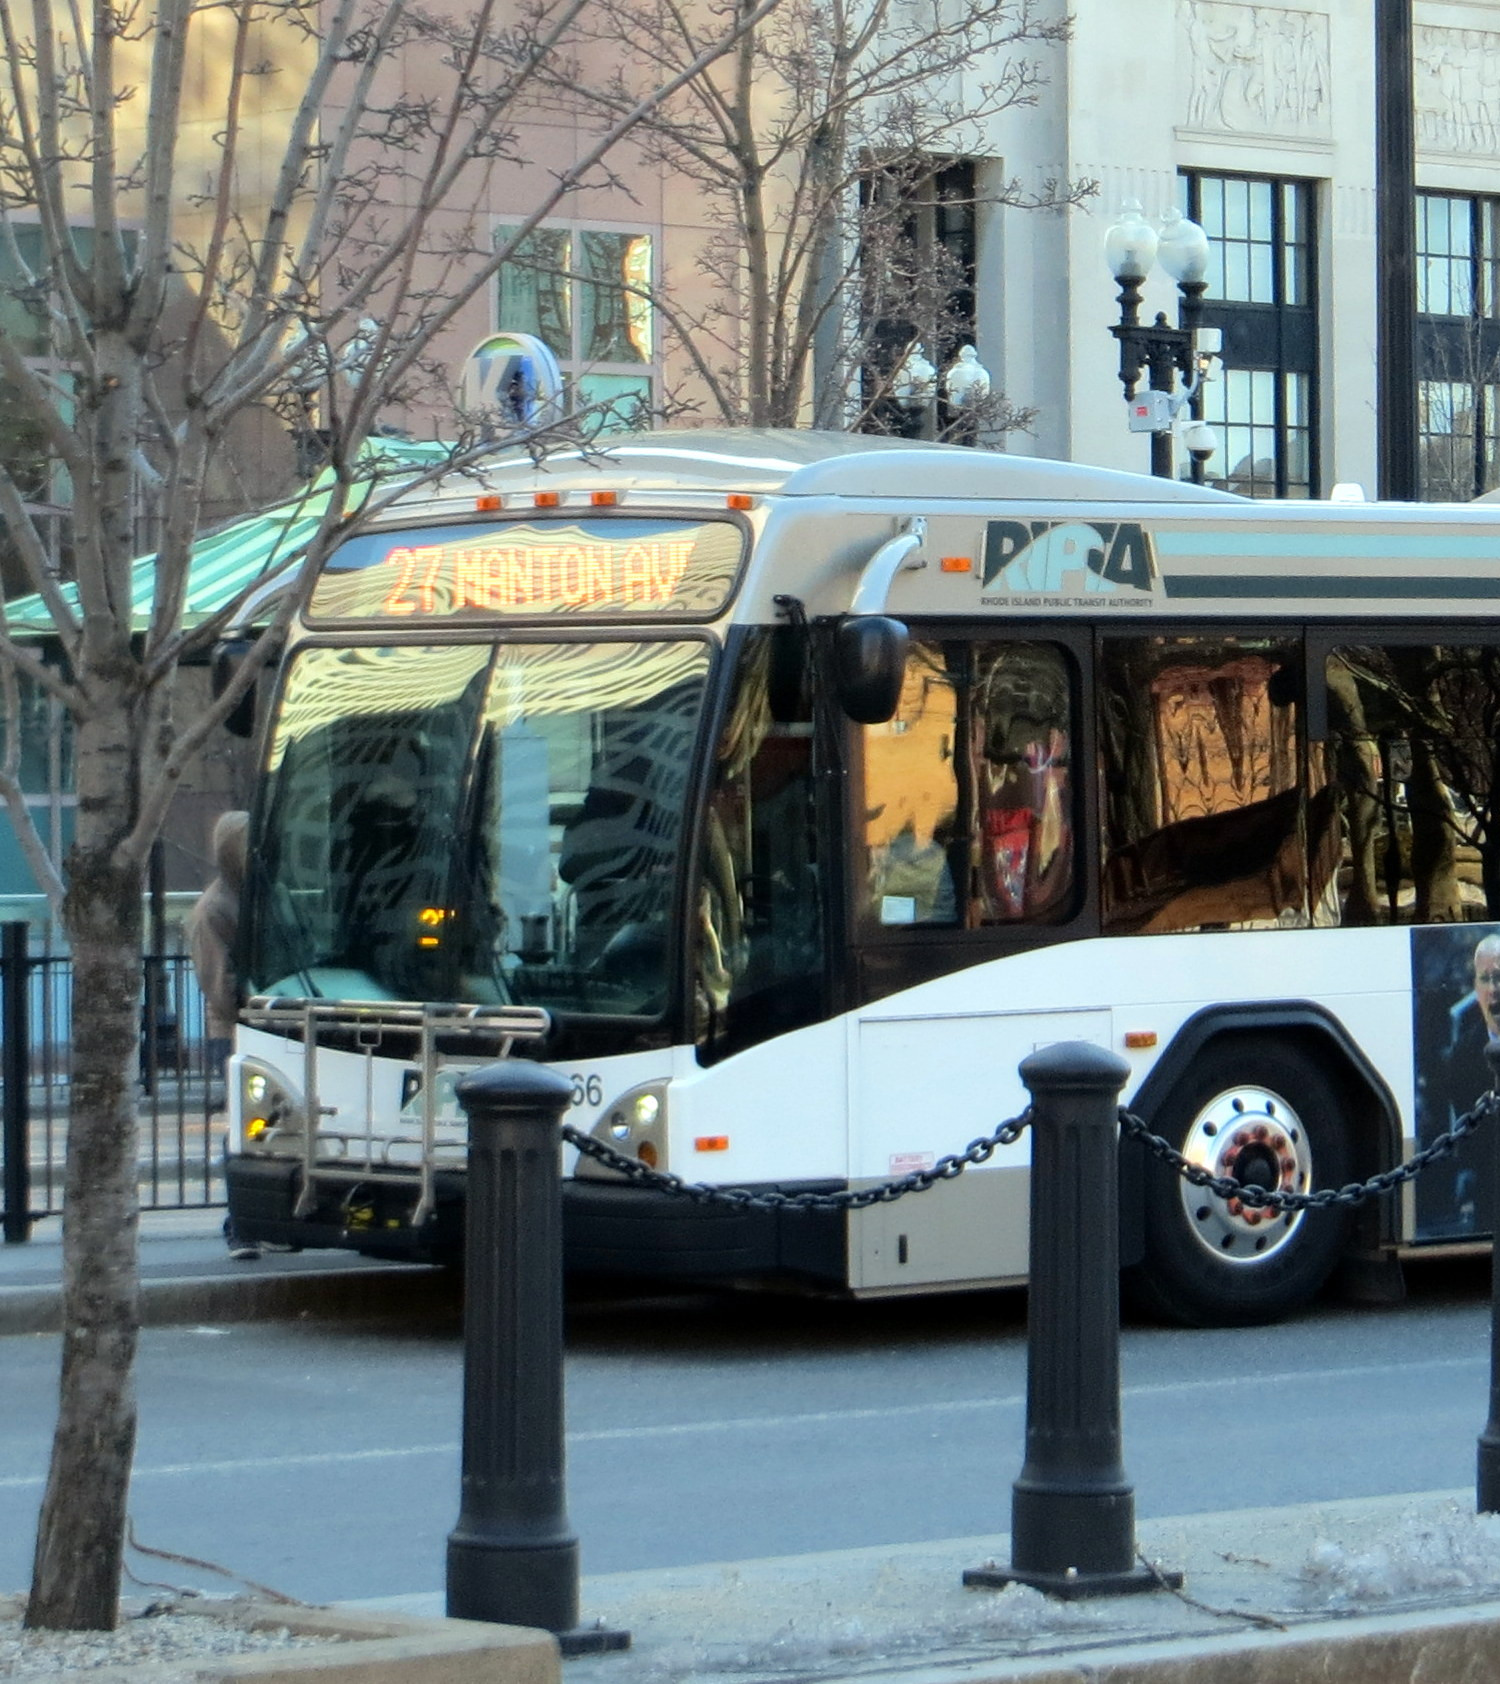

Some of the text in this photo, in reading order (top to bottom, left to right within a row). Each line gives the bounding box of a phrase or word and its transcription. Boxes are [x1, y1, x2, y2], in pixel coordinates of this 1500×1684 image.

[385, 545, 444, 614] 27
[454, 544, 614, 607] MANTON
[1011, 596, 1040, 607] ISLAND
